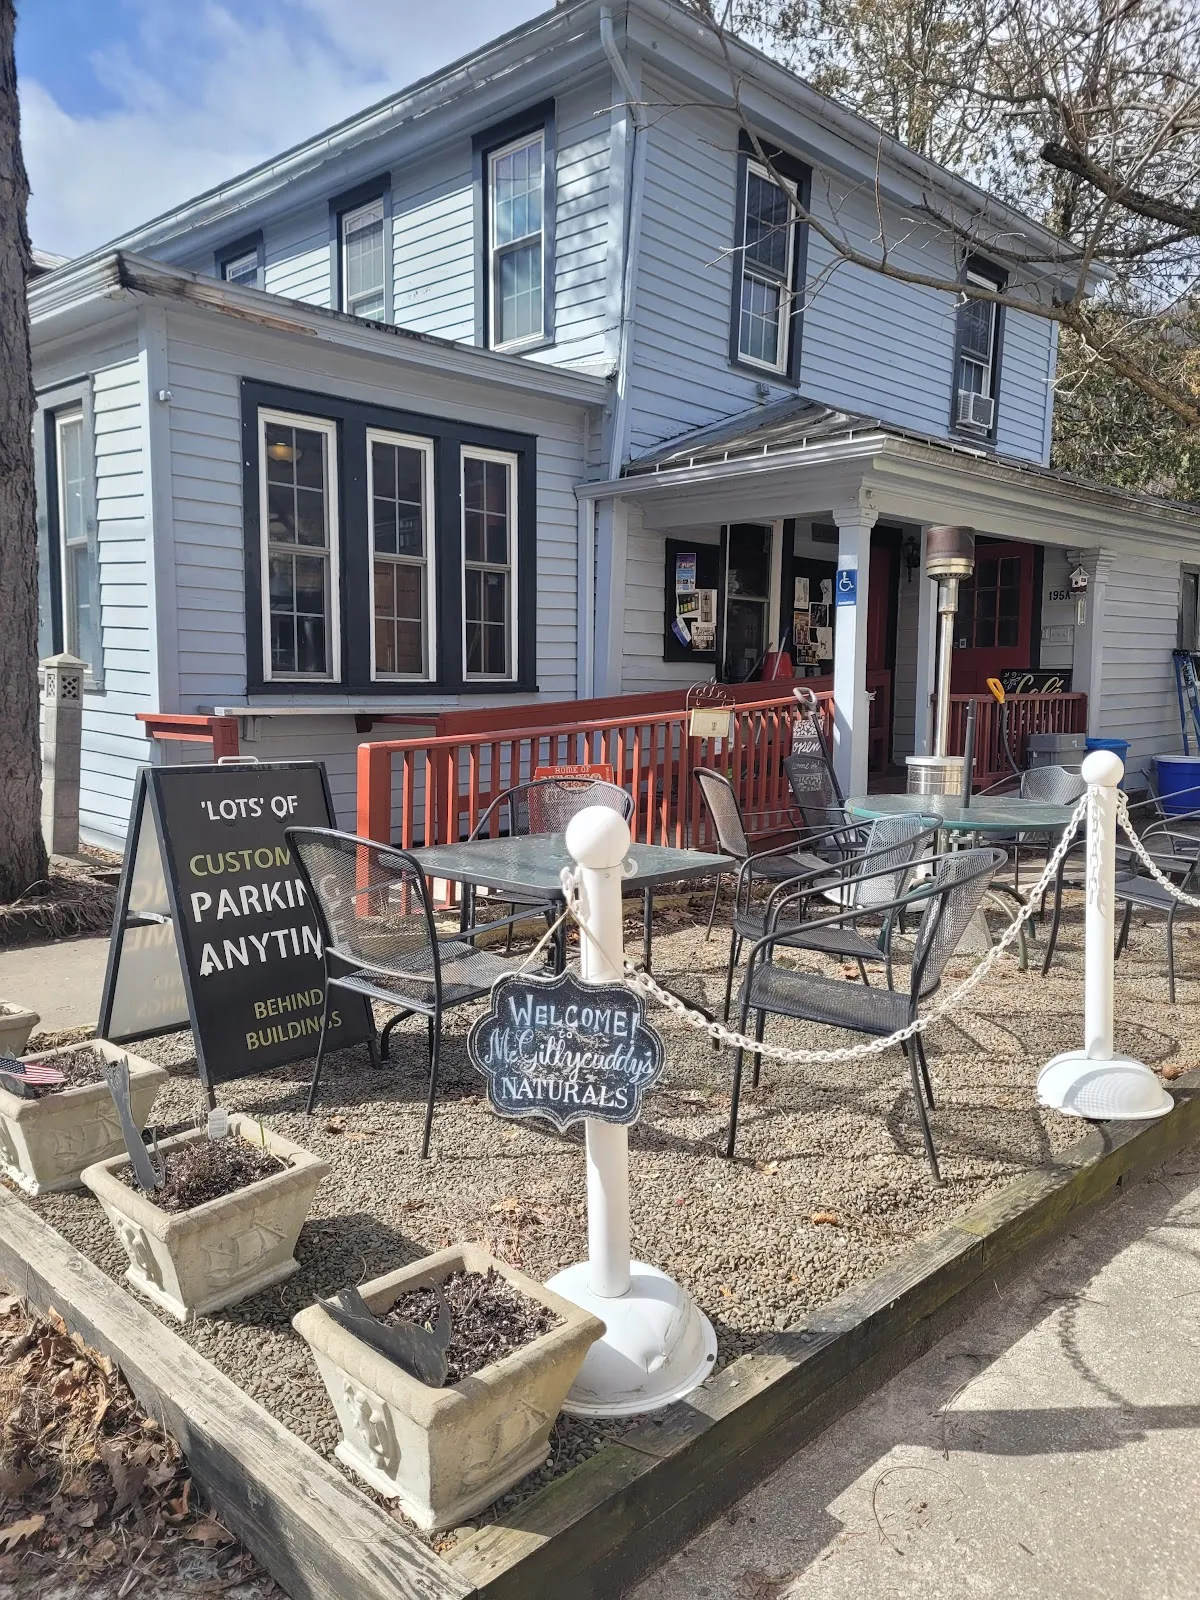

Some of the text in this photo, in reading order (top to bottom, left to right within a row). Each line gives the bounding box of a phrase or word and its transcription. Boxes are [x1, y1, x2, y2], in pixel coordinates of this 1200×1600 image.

[792, 741, 821, 754] open
[554, 765, 592, 774] HOME OF
[270, 794, 299, 819] OF
[254, 987, 324, 1020] BEHIND
[245, 1009, 343, 1050] BUILDINGS
[559, 1029, 573, 1038] to
[501, 1077, 628, 1109] NATURALS
